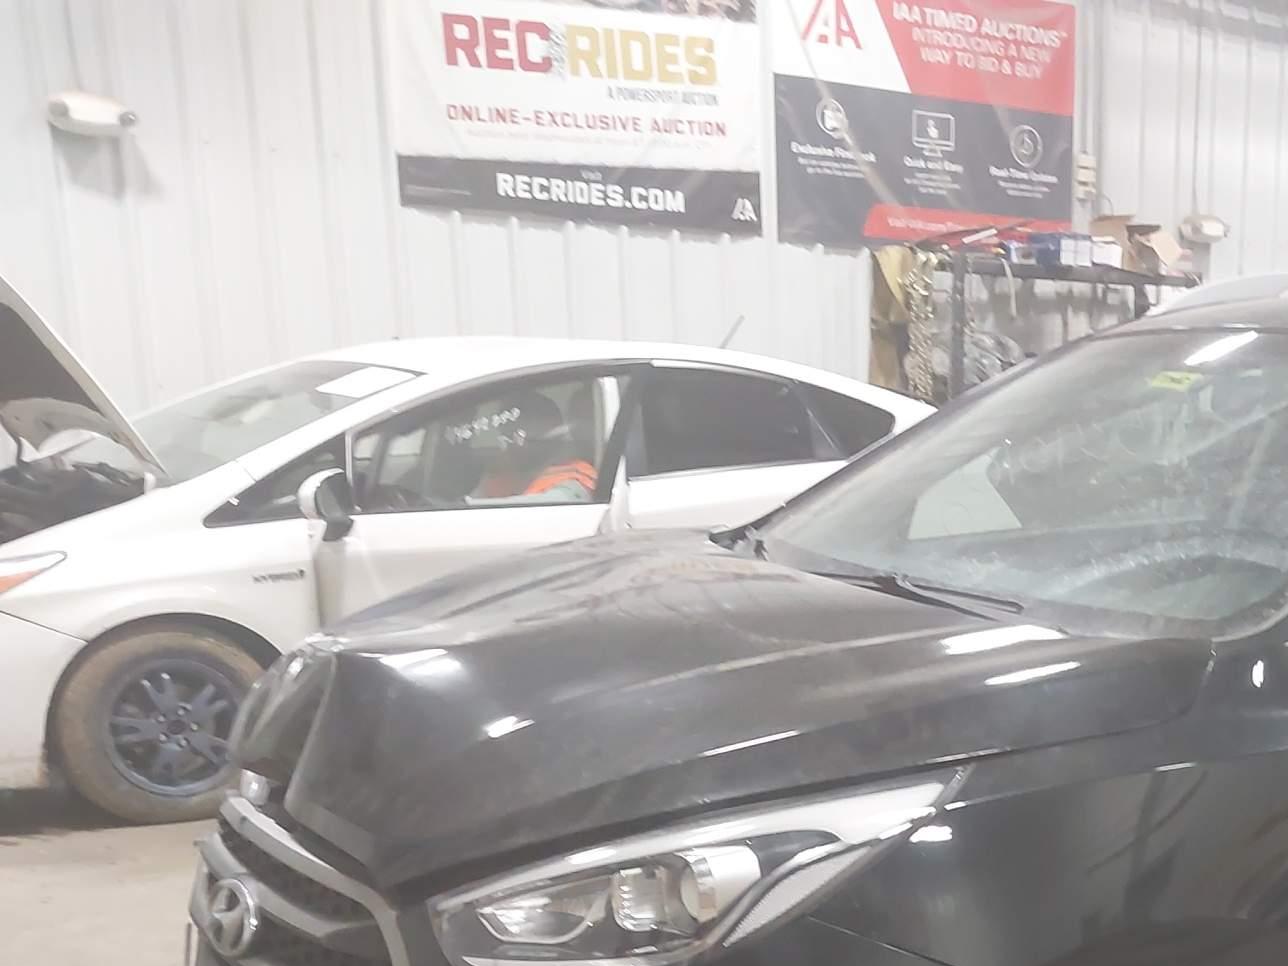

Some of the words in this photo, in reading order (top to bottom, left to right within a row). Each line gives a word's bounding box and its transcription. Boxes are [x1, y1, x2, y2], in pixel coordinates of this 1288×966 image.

[892, 2, 922, 24] IAA
[924, 8, 977, 33] TIMED
[564, 24, 718, 86] RIDES
[912, 27, 1005, 57] INTRODUCING
[1008, 43, 1018, 57] A
[1020, 45, 1052, 63] NEW
[920, 48, 951, 65] WAY
[956, 51, 975, 67] TO
[977, 56, 999, 73] BID
[1000, 60, 1012, 75] &
[1015, 62, 1043, 80] BUY
[447, 103, 641, 133] ONLINE-EXCLUSIVE
[650, 117, 726, 137] AUCTION
[495, 173, 686, 214] RECRIDES.COM
